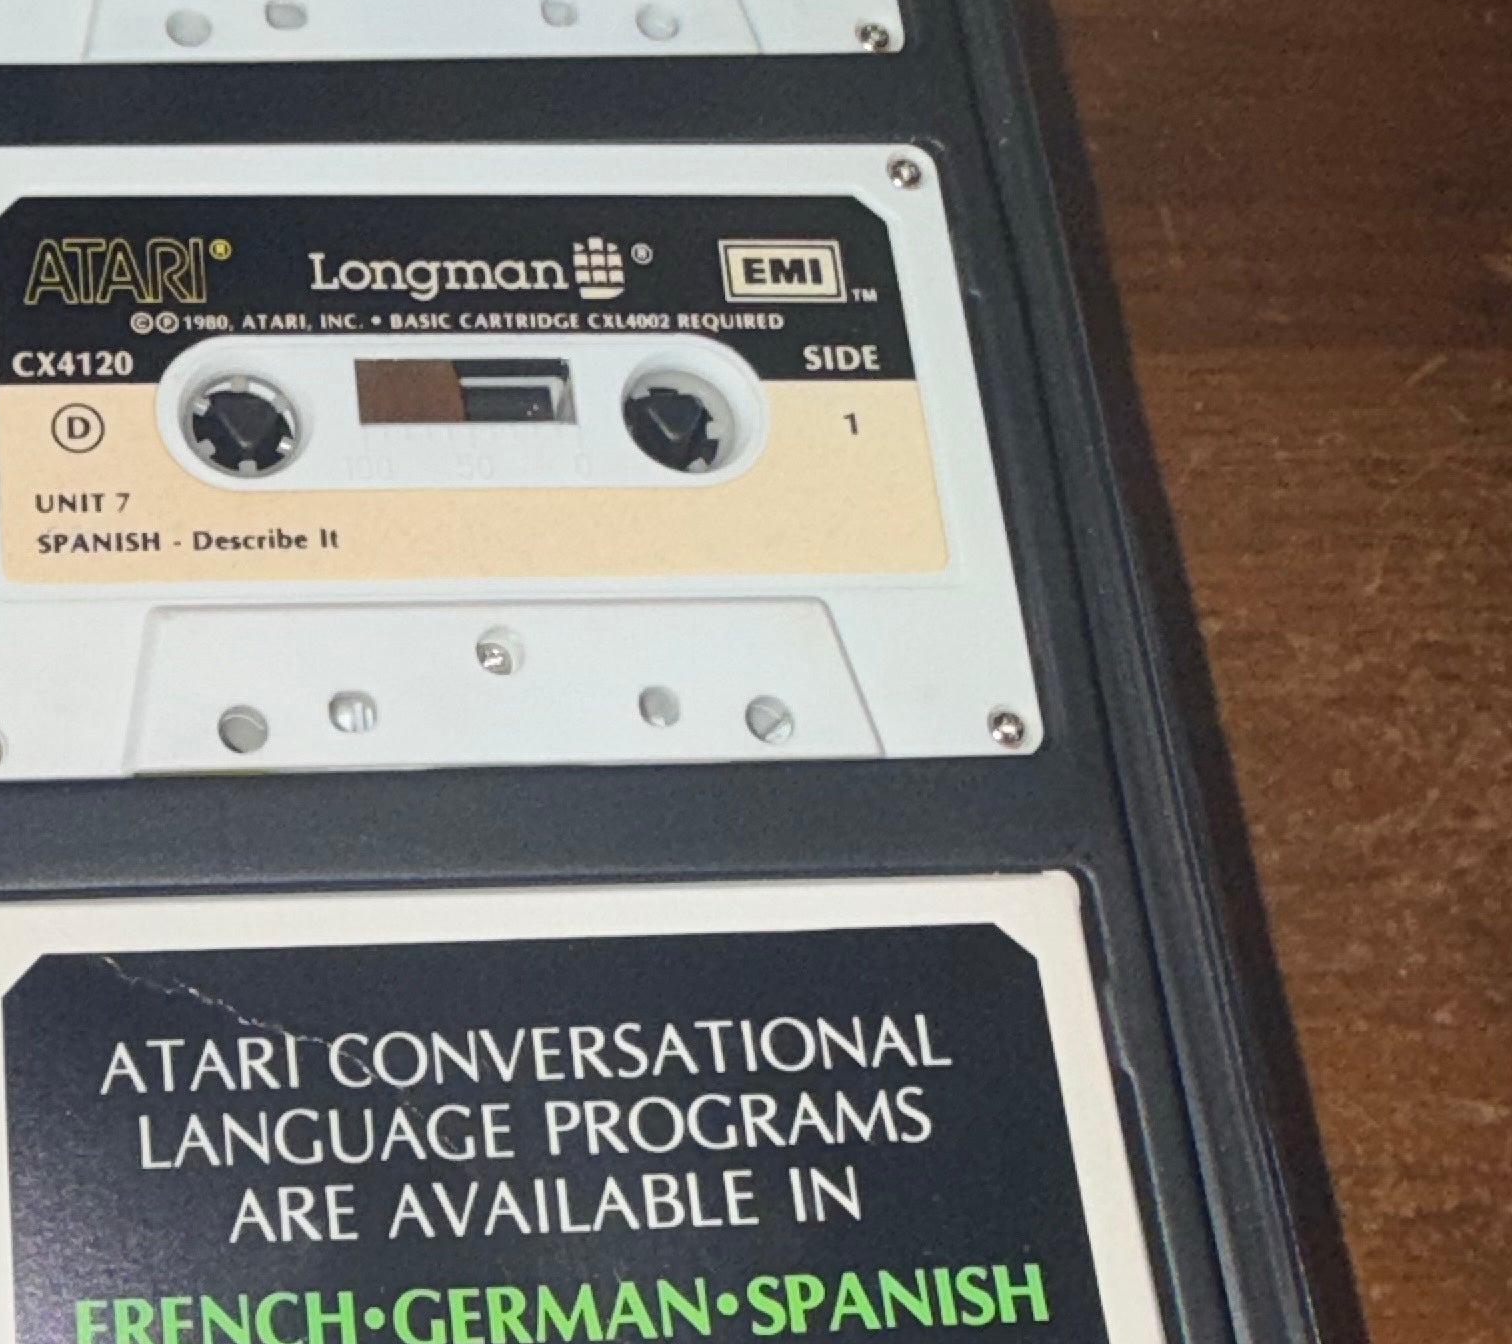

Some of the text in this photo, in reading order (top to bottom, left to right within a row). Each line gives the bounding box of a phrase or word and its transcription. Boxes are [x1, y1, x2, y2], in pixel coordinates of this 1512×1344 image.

[309, 253, 569, 301] Longman
[743, 256, 822, 284] EMI
[391, 313, 450, 329] BASIC
[459, 312, 580, 330] CARTRIDGE
[588, 312, 670, 330] CXL4002
[677, 313, 784, 332] REQUIRED
[13, 351, 133, 377] CX4120
[803, 345, 879, 370] SIDE
[844, 413, 858, 435] 1
[35, 493, 129, 513] UNIT 7
[37, 532, 160, 553] SPANISH
[193, 528, 307, 551] Describe
[320, 529, 338, 548] It
[101, 1015, 952, 1095] ATARI CONVERSATIONAL
[139, 1087, 931, 1169] LANGUAGE PROGRAMS
[229, 1165, 861, 1243] ARE AVAILABLE IN
